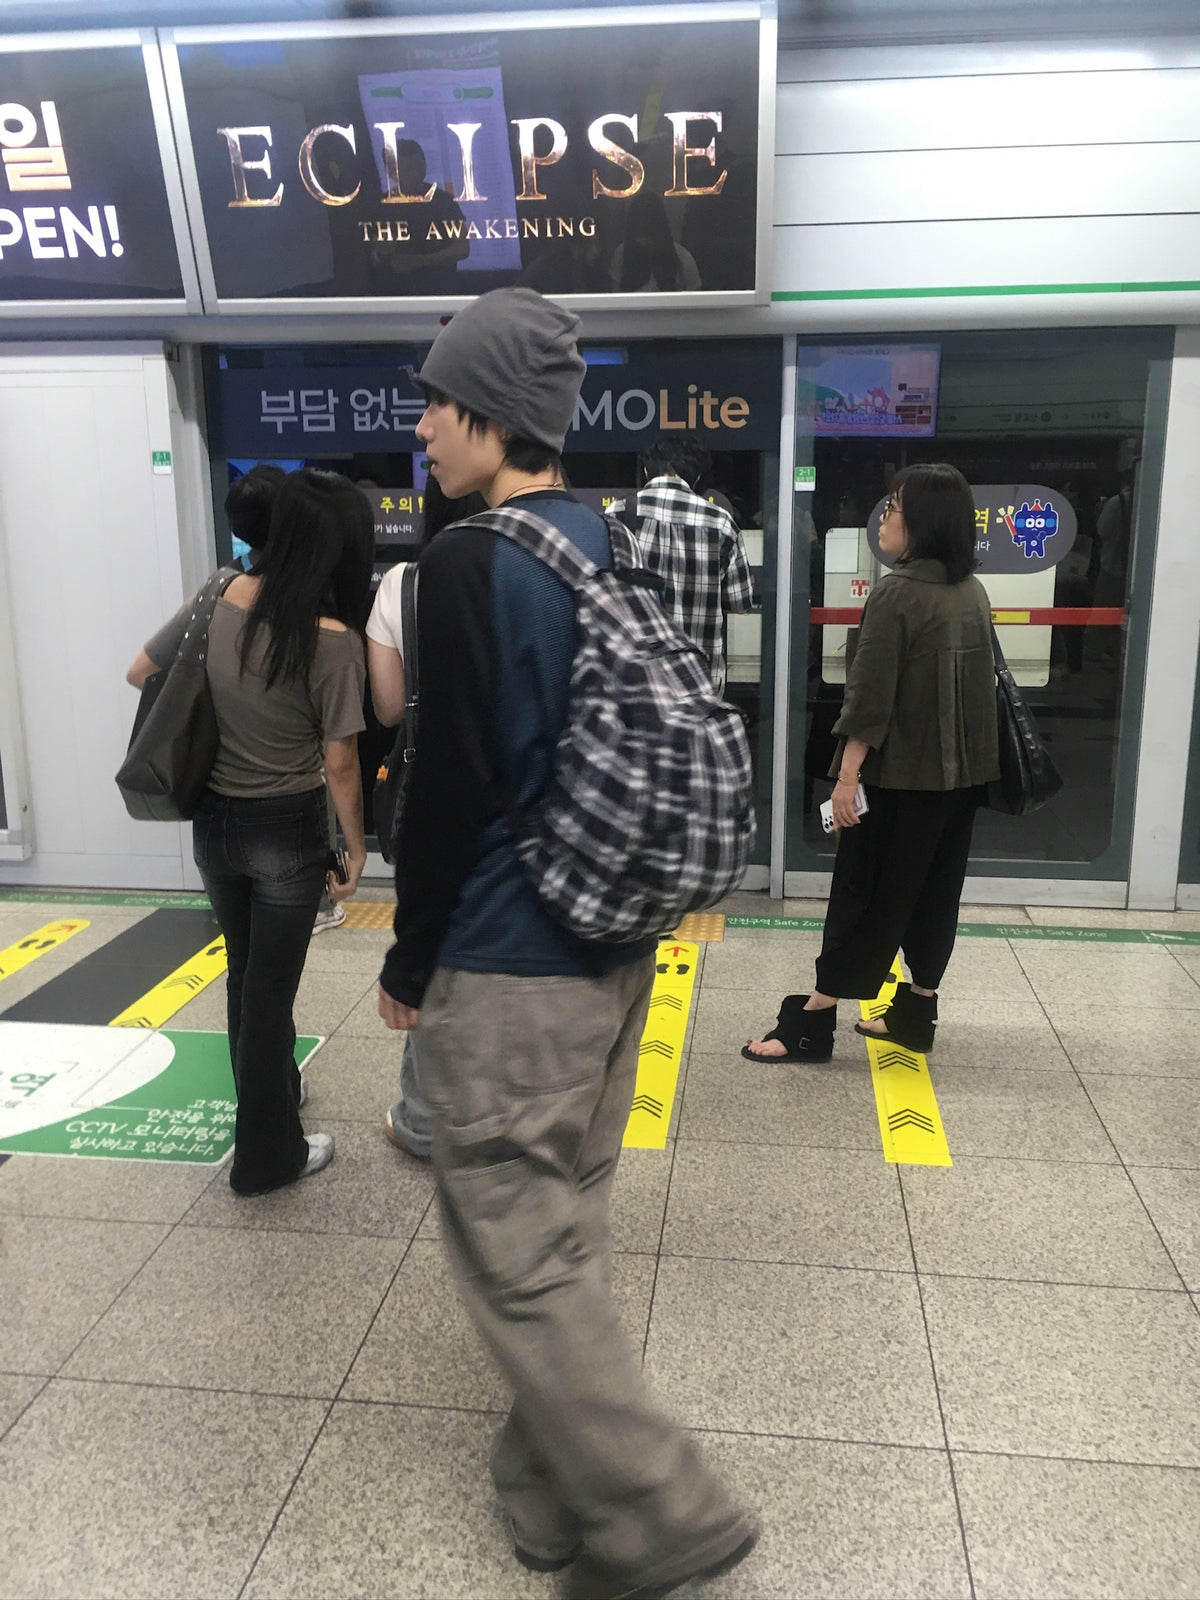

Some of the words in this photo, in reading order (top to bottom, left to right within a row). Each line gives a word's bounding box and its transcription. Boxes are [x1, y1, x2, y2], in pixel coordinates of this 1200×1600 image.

[0, 101, 72, 192] 일
[217, 111, 728, 208] ECLIPSE
[358, 219, 411, 242] THE
[425, 217, 597, 240] AWAKENING
[260, 388, 339, 434] 부담
[350, 387, 427, 432] 없는
[774, 918, 799, 926] Safe
[65, 1120, 128, 1134] CCTV
